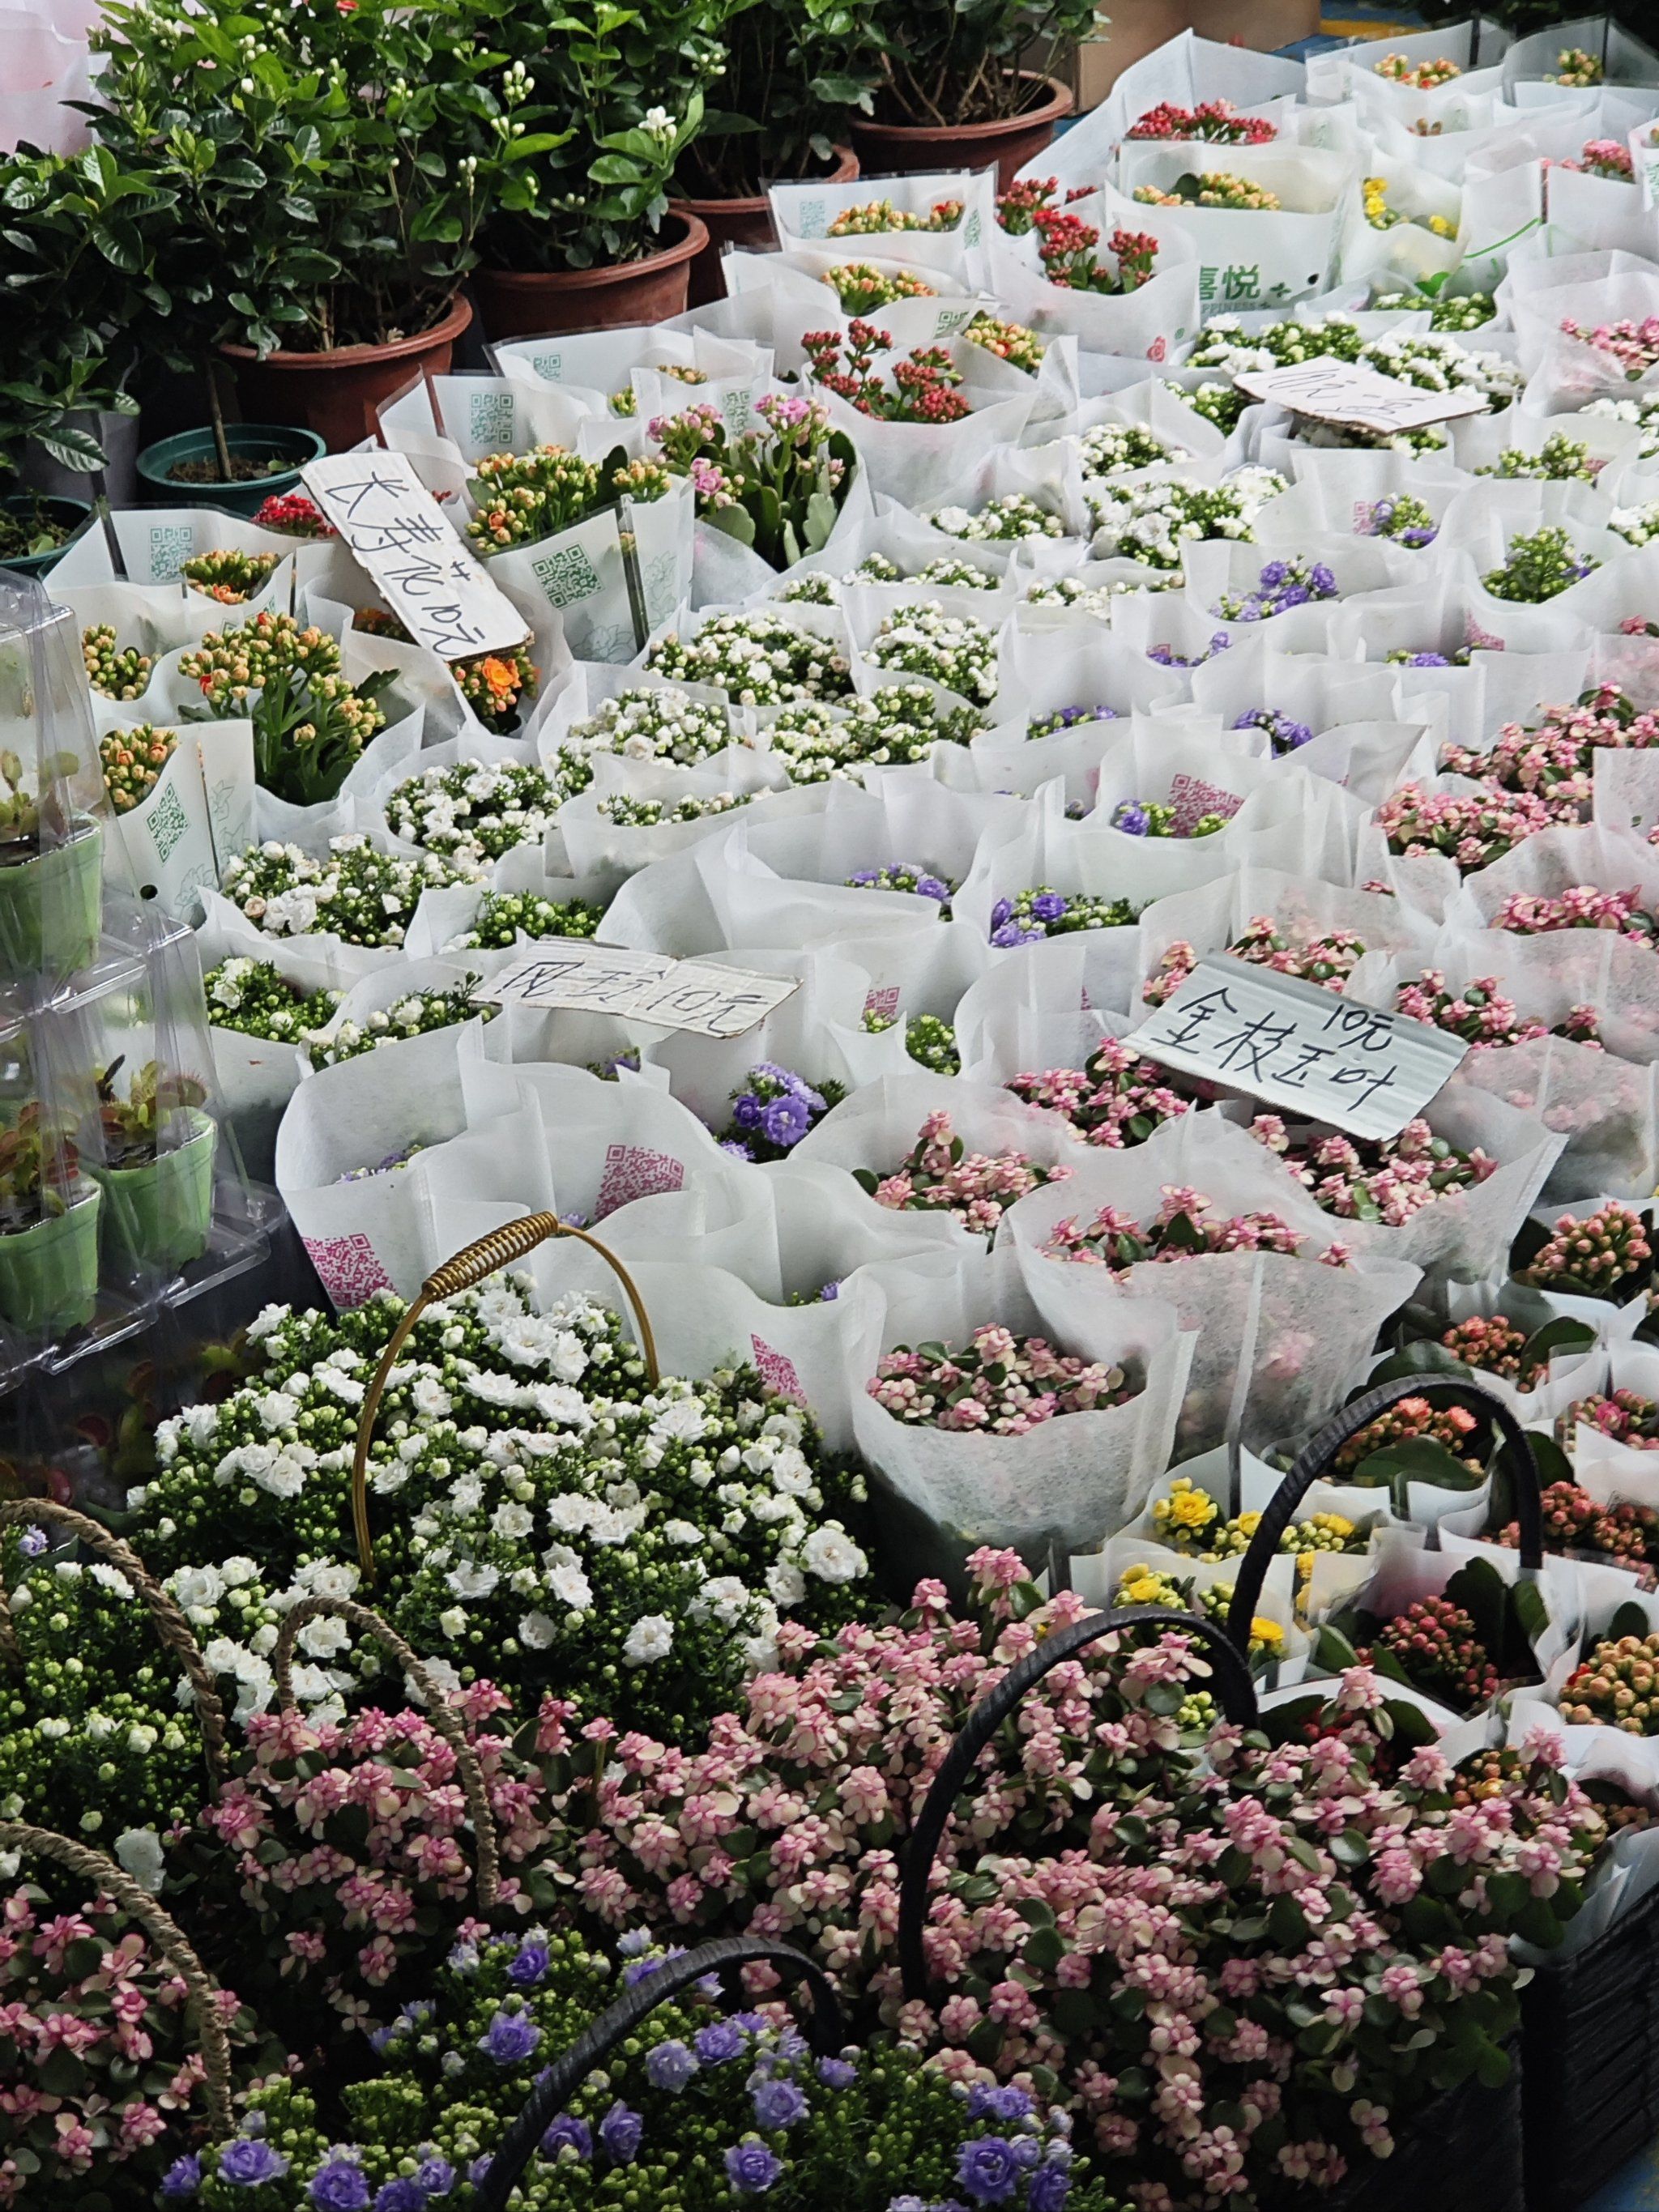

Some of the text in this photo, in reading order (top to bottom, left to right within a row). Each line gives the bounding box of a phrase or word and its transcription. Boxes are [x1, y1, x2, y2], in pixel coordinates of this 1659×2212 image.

[1150, 987, 1398, 1112] 金枝玉叶
[1323, 1004, 1394, 1051] 10元
